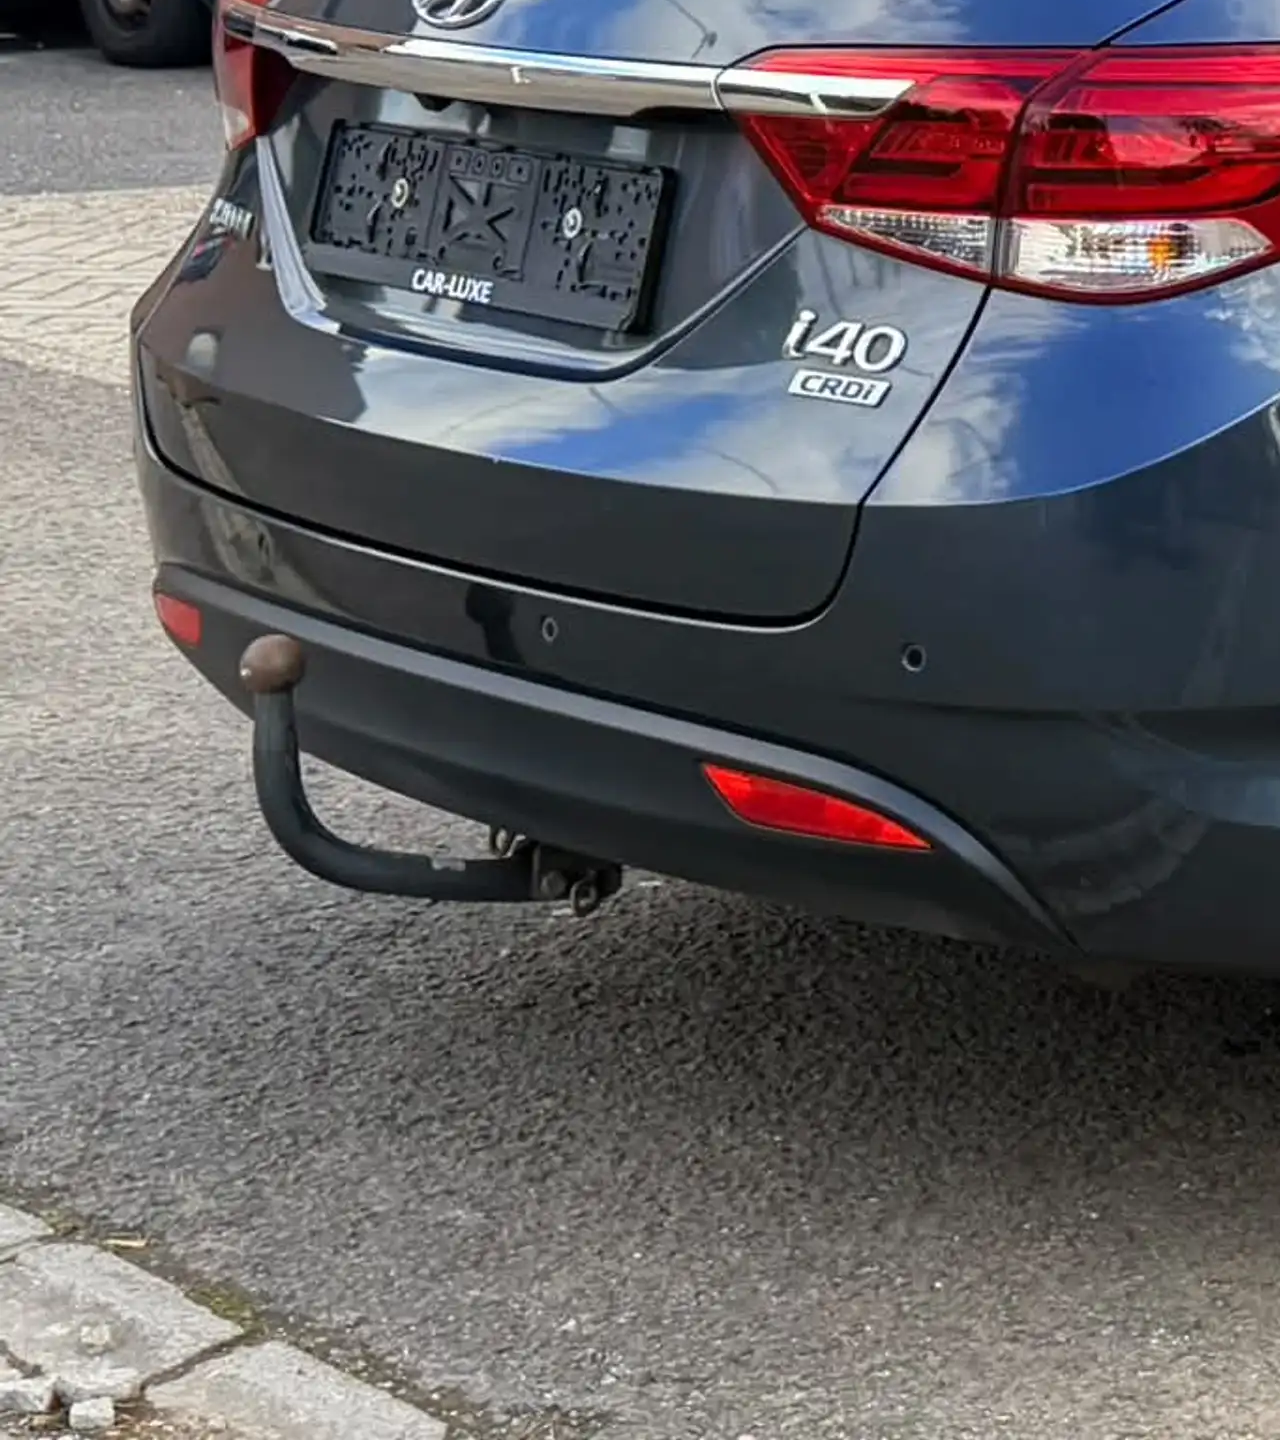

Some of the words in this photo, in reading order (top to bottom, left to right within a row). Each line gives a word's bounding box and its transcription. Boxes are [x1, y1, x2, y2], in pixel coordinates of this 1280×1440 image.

[412, 268, 494, 304] CAR-LUXE
[782, 309, 906, 372] i40
[800, 375, 876, 401] CRDi
